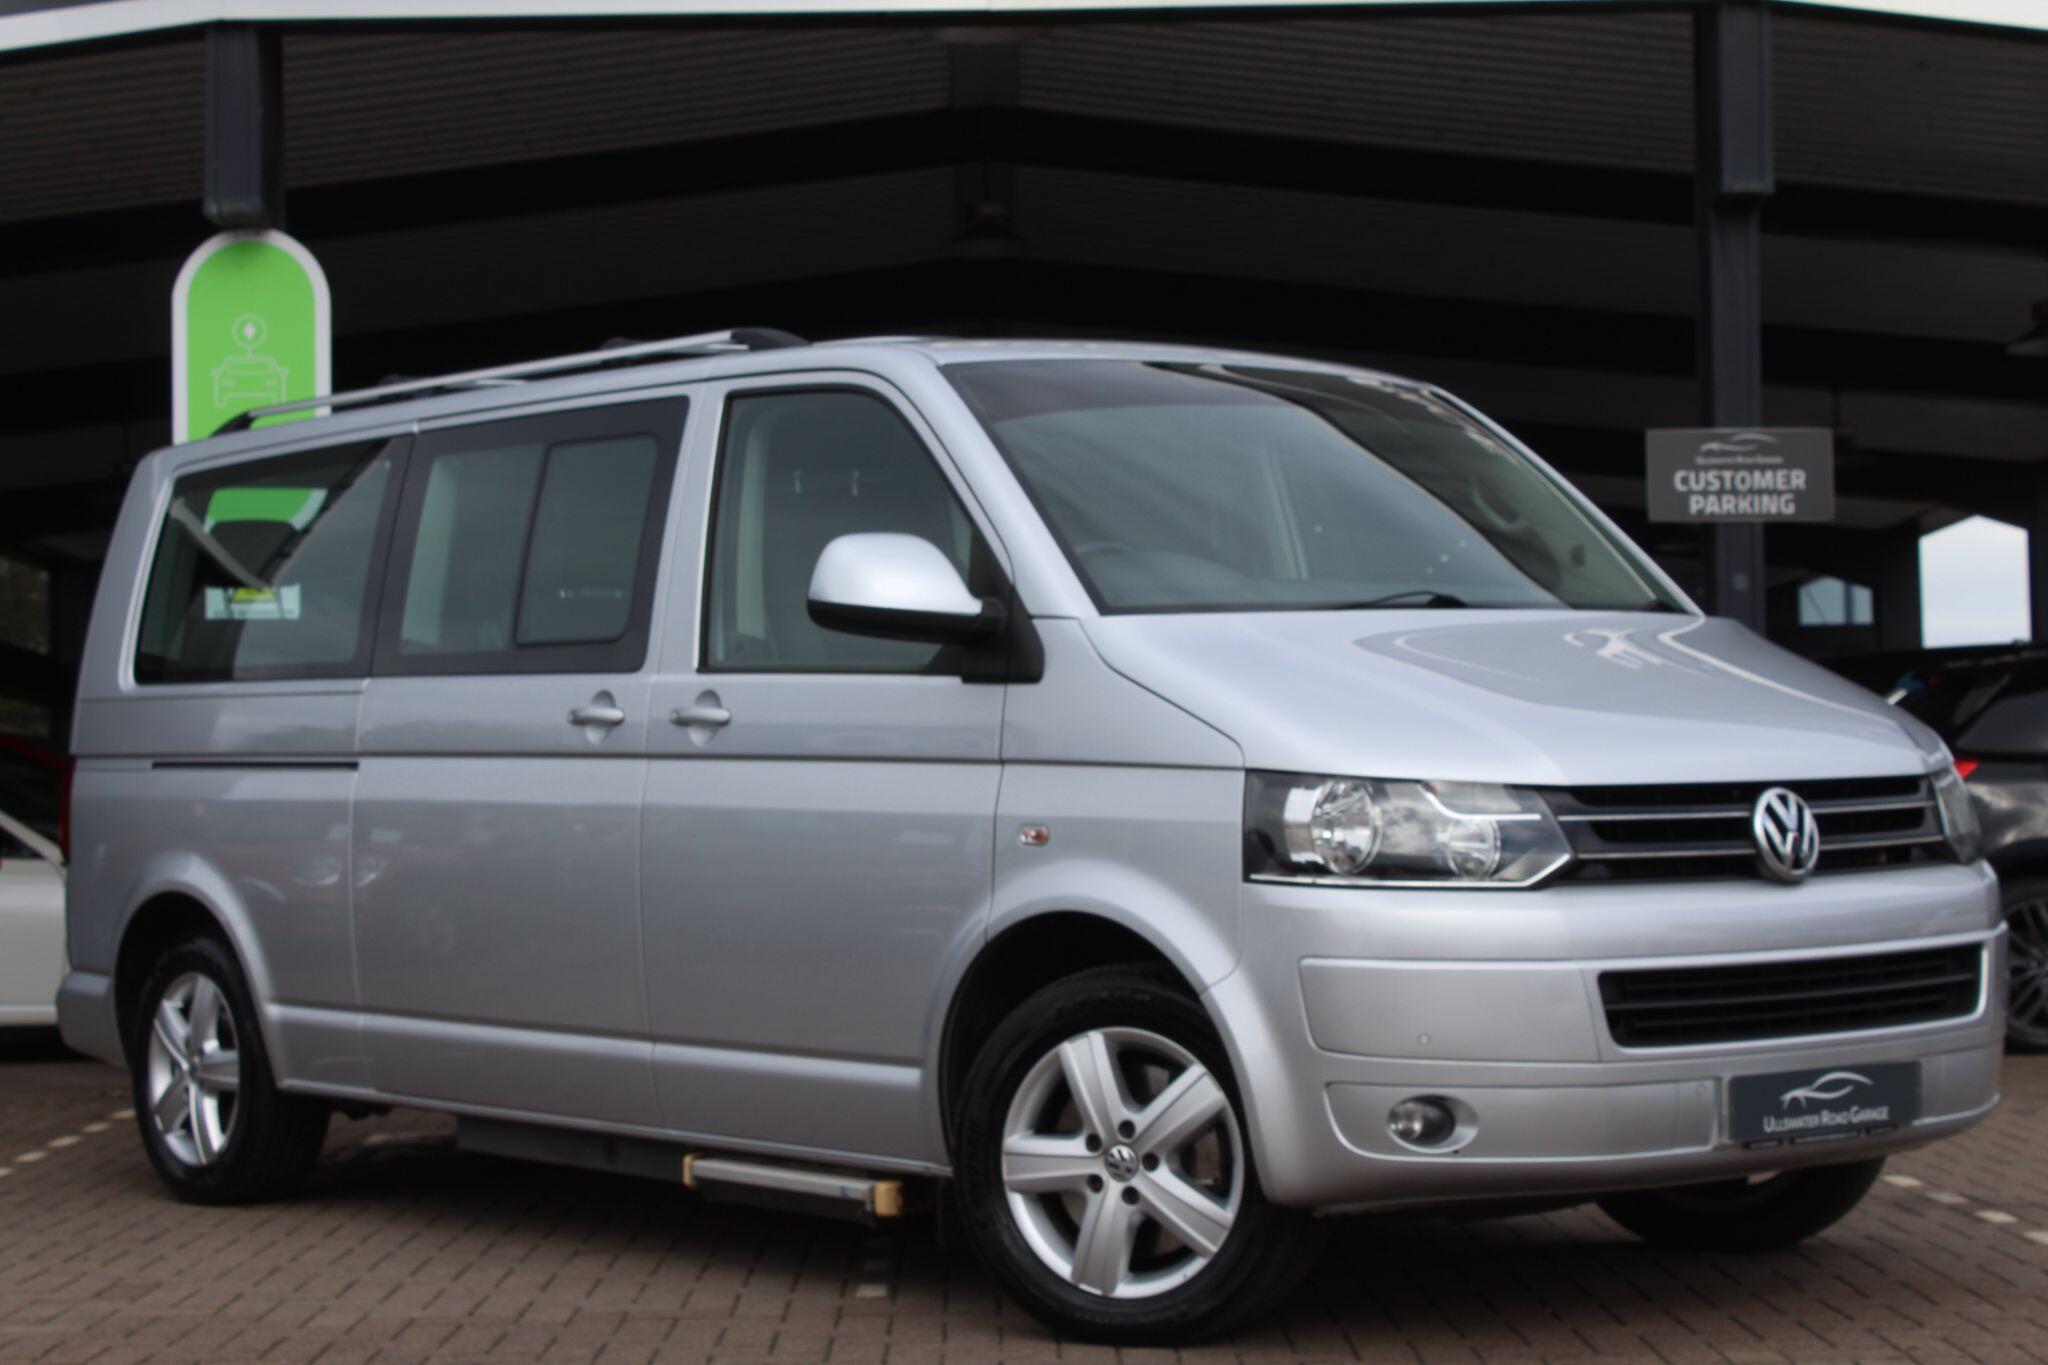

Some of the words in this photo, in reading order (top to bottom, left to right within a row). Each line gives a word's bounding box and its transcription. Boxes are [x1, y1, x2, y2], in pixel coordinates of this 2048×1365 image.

[1673, 469, 1807, 491] CUSTOMER
[1689, 493, 1796, 515] PARKING
[1821, 1109, 1849, 1126] ROAD
[1850, 1105, 1890, 1124] GARAGE
